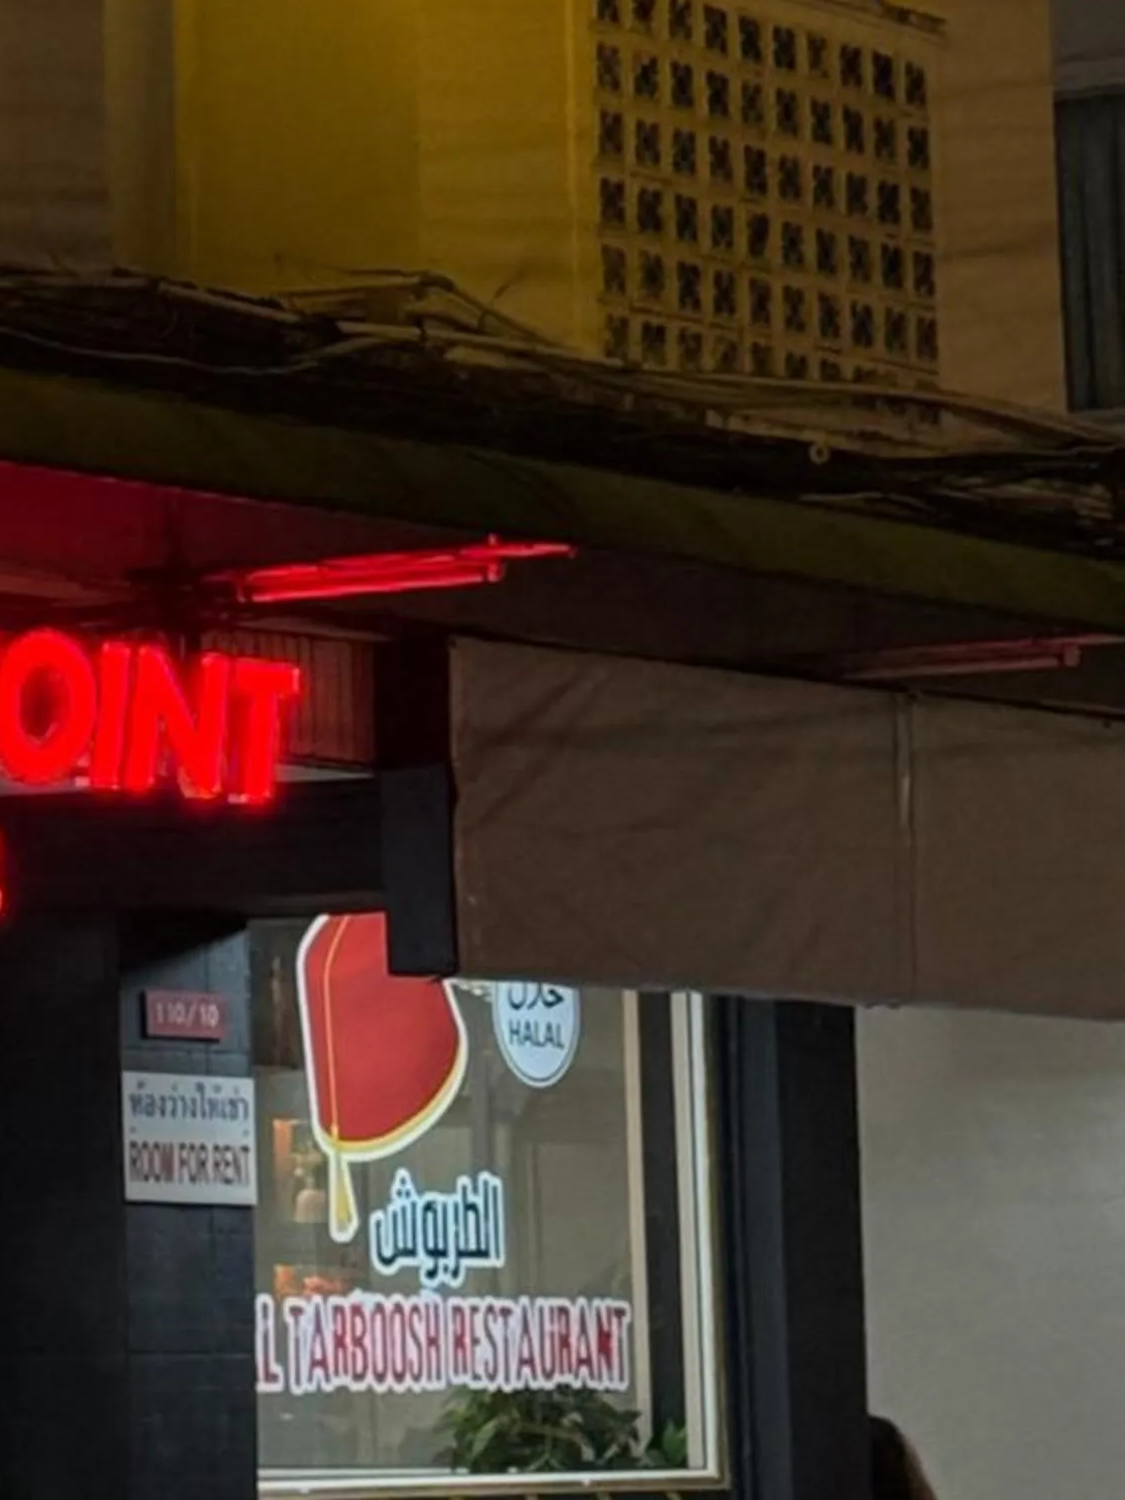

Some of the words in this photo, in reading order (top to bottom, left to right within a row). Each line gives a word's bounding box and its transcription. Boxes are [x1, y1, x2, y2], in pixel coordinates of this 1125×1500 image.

[155, 1002, 220, 1029] 110/10
[508, 1019, 565, 1050] HALAL
[129, 1140, 174, 1183] ROOM
[178, 1141, 211, 1185] FOR
[212, 1143, 251, 1186] RENT
[375, 1176, 500, 1280] الطربوش
[287, 1302, 442, 1386] TARBOOSH
[452, 1303, 627, 1385] RESTAURANT
